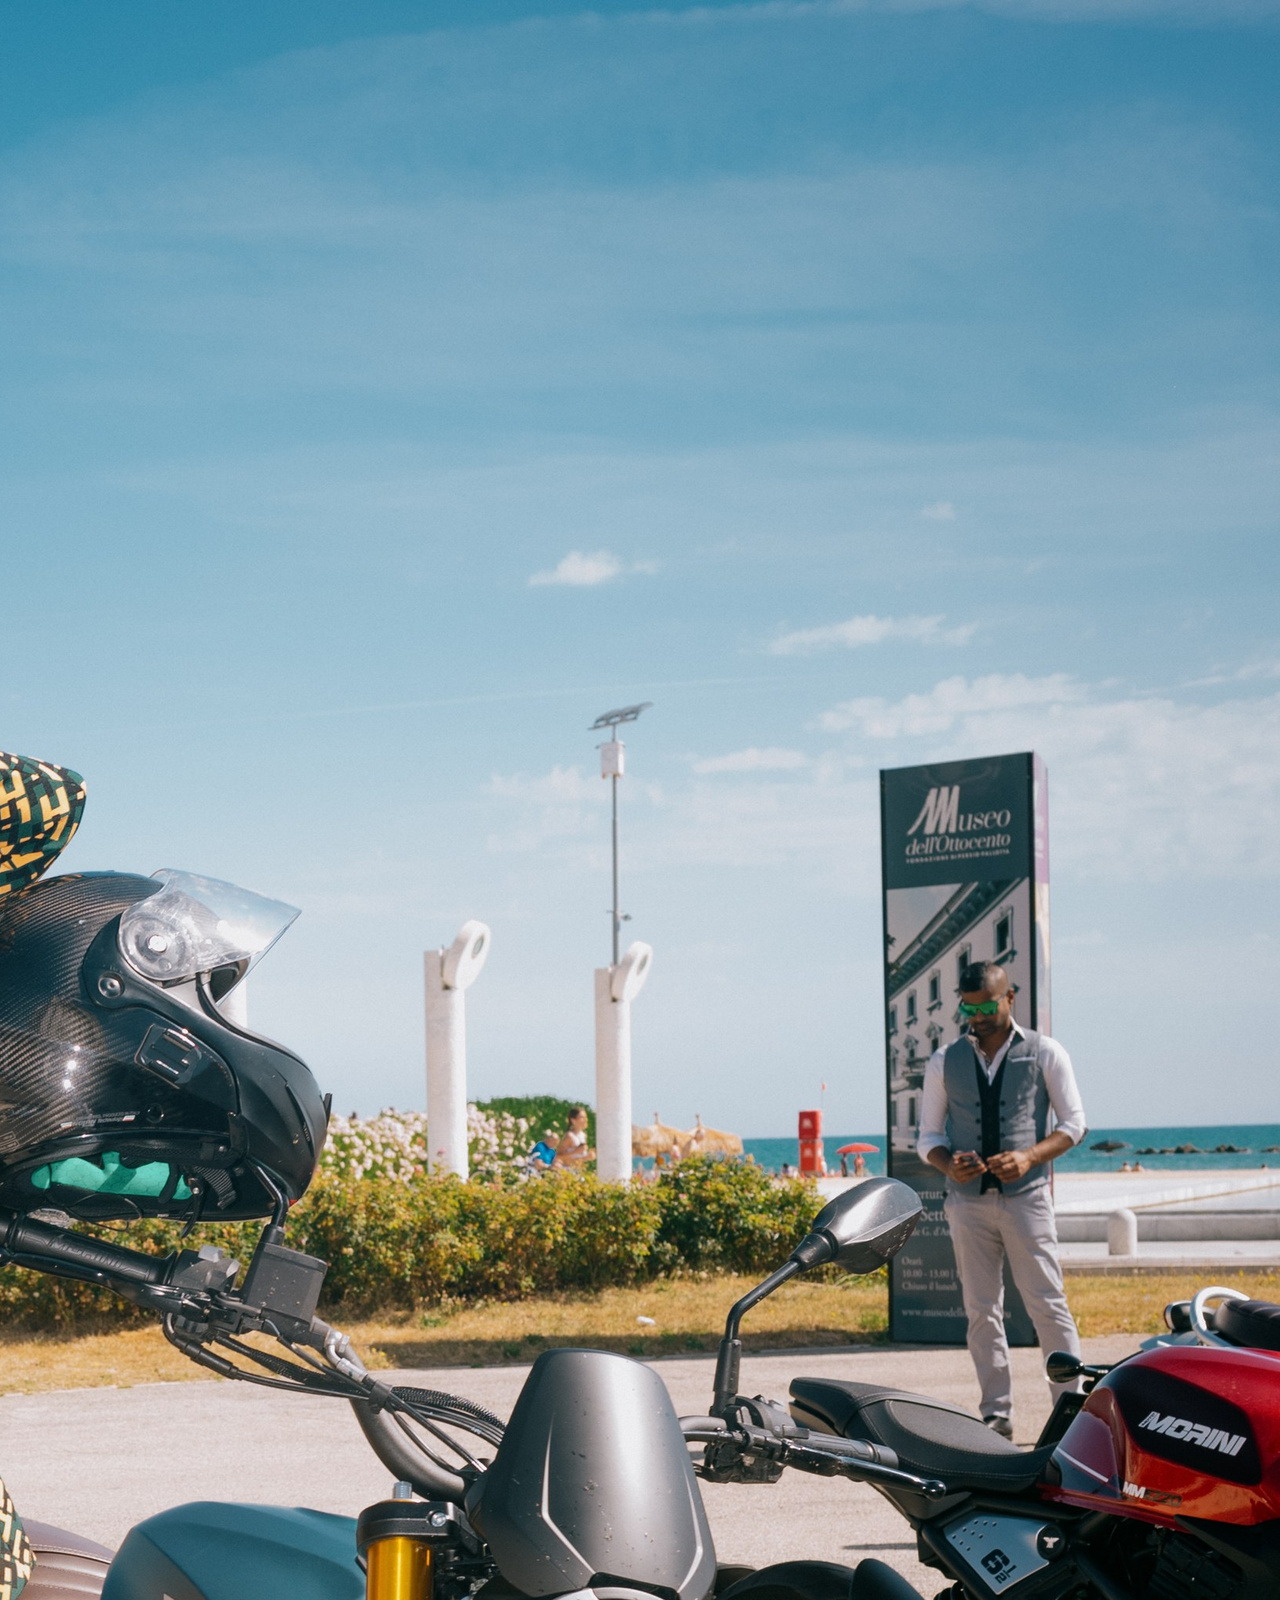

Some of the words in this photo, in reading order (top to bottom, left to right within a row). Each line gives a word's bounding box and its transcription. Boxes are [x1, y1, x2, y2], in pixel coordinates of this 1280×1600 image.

[906, 784, 1011, 836] Museo
[905, 833, 1011, 856] dell'Ottocento
[1138, 1410, 1247, 1457] MORINI
